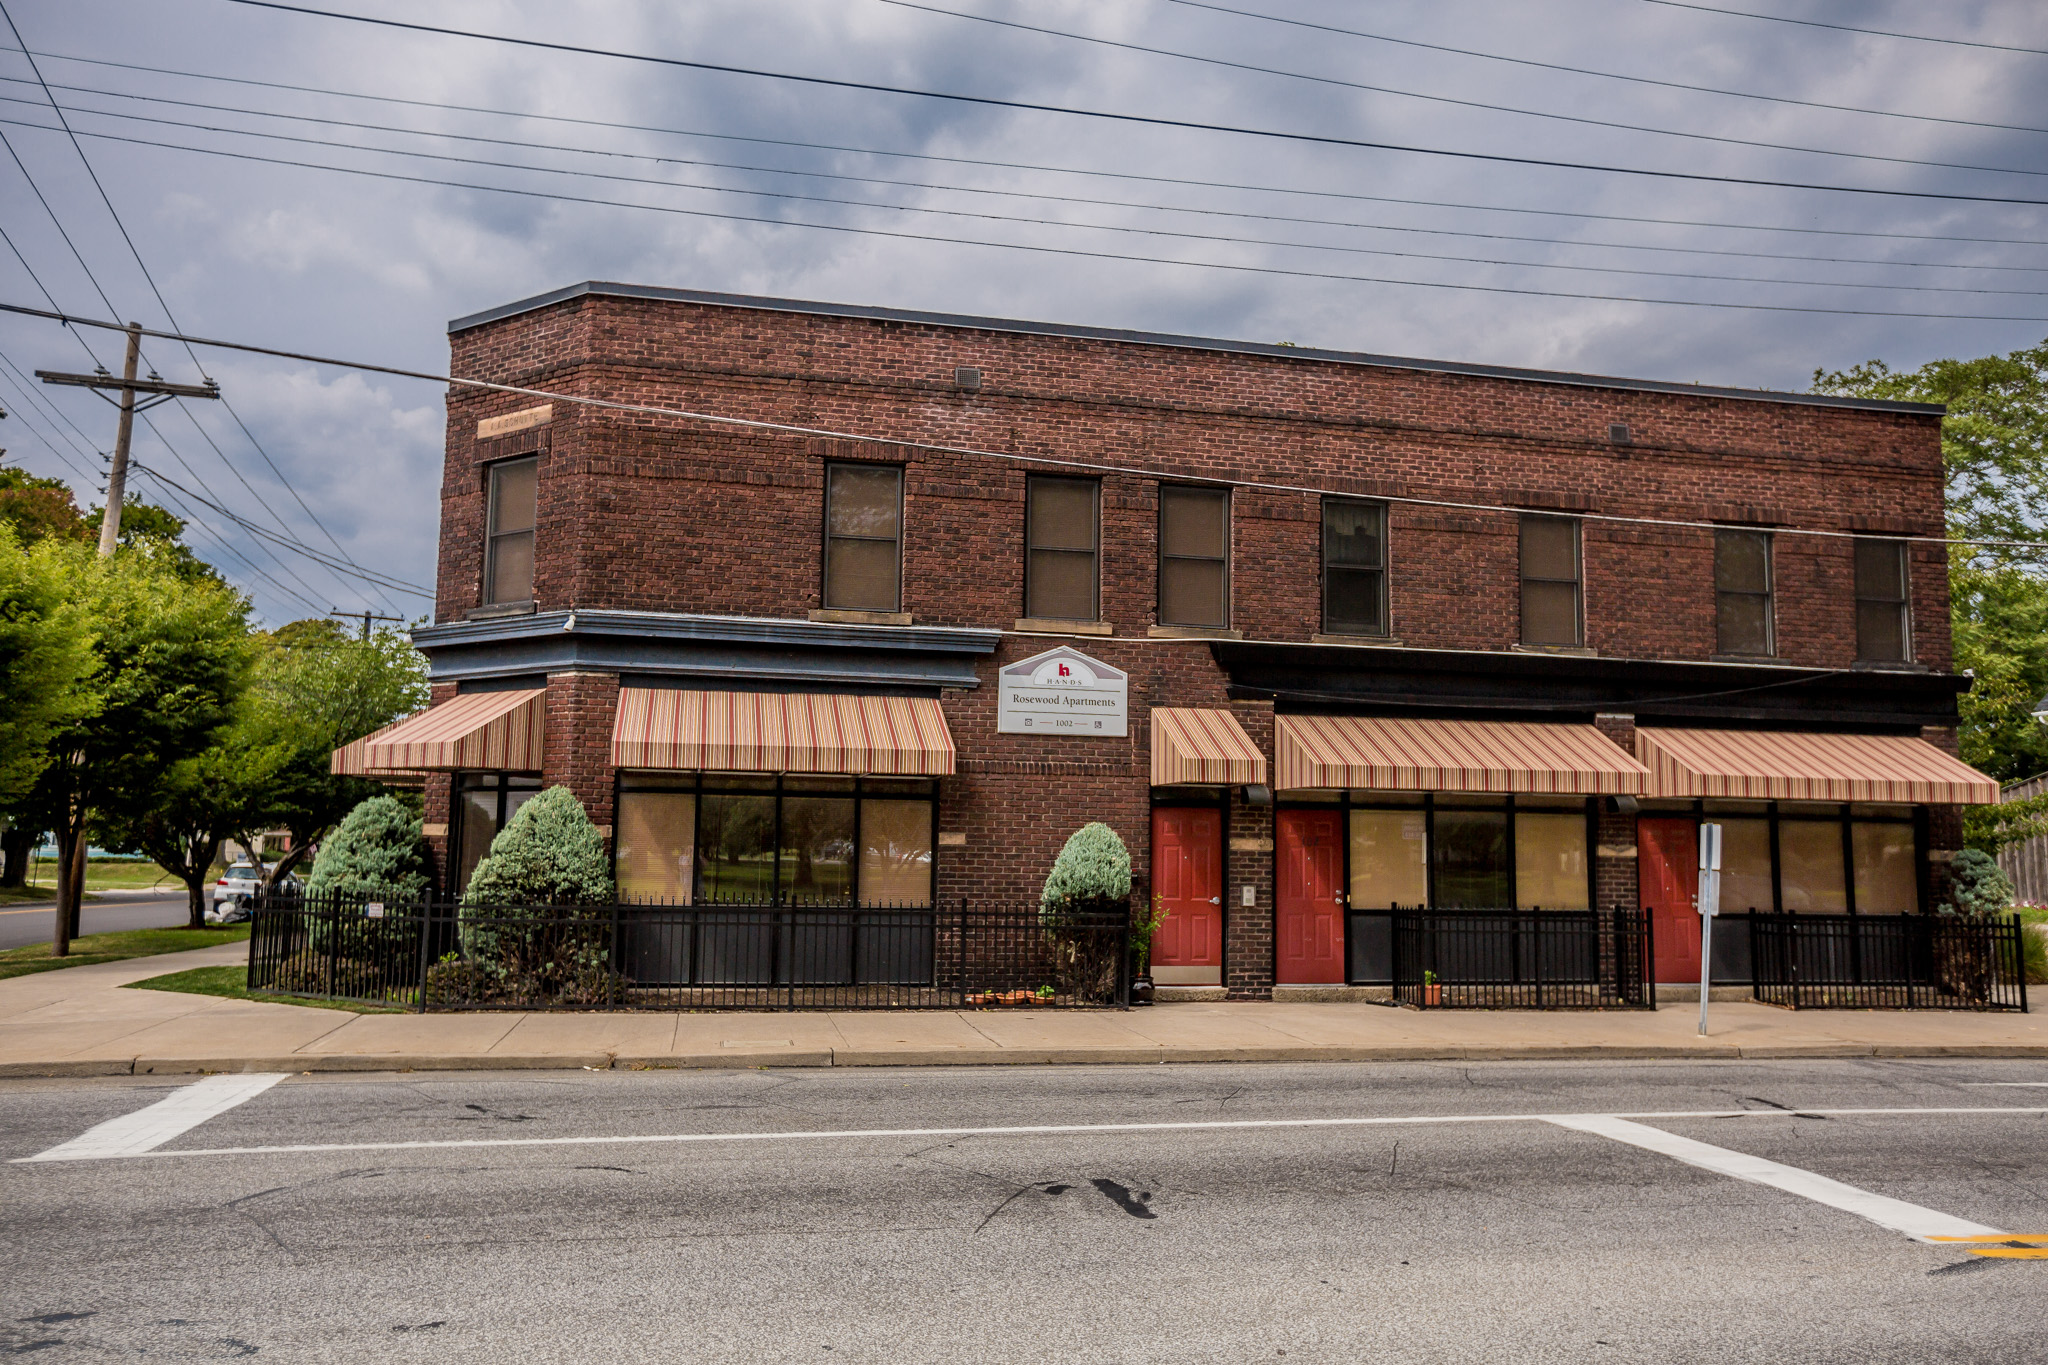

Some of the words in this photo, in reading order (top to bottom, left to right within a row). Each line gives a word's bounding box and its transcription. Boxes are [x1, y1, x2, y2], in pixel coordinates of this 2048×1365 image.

[1012, 693, 1060, 705] Rosewood
[1062, 696, 1116, 707] Apartments
[1055, 719, 1073, 727] 1002
